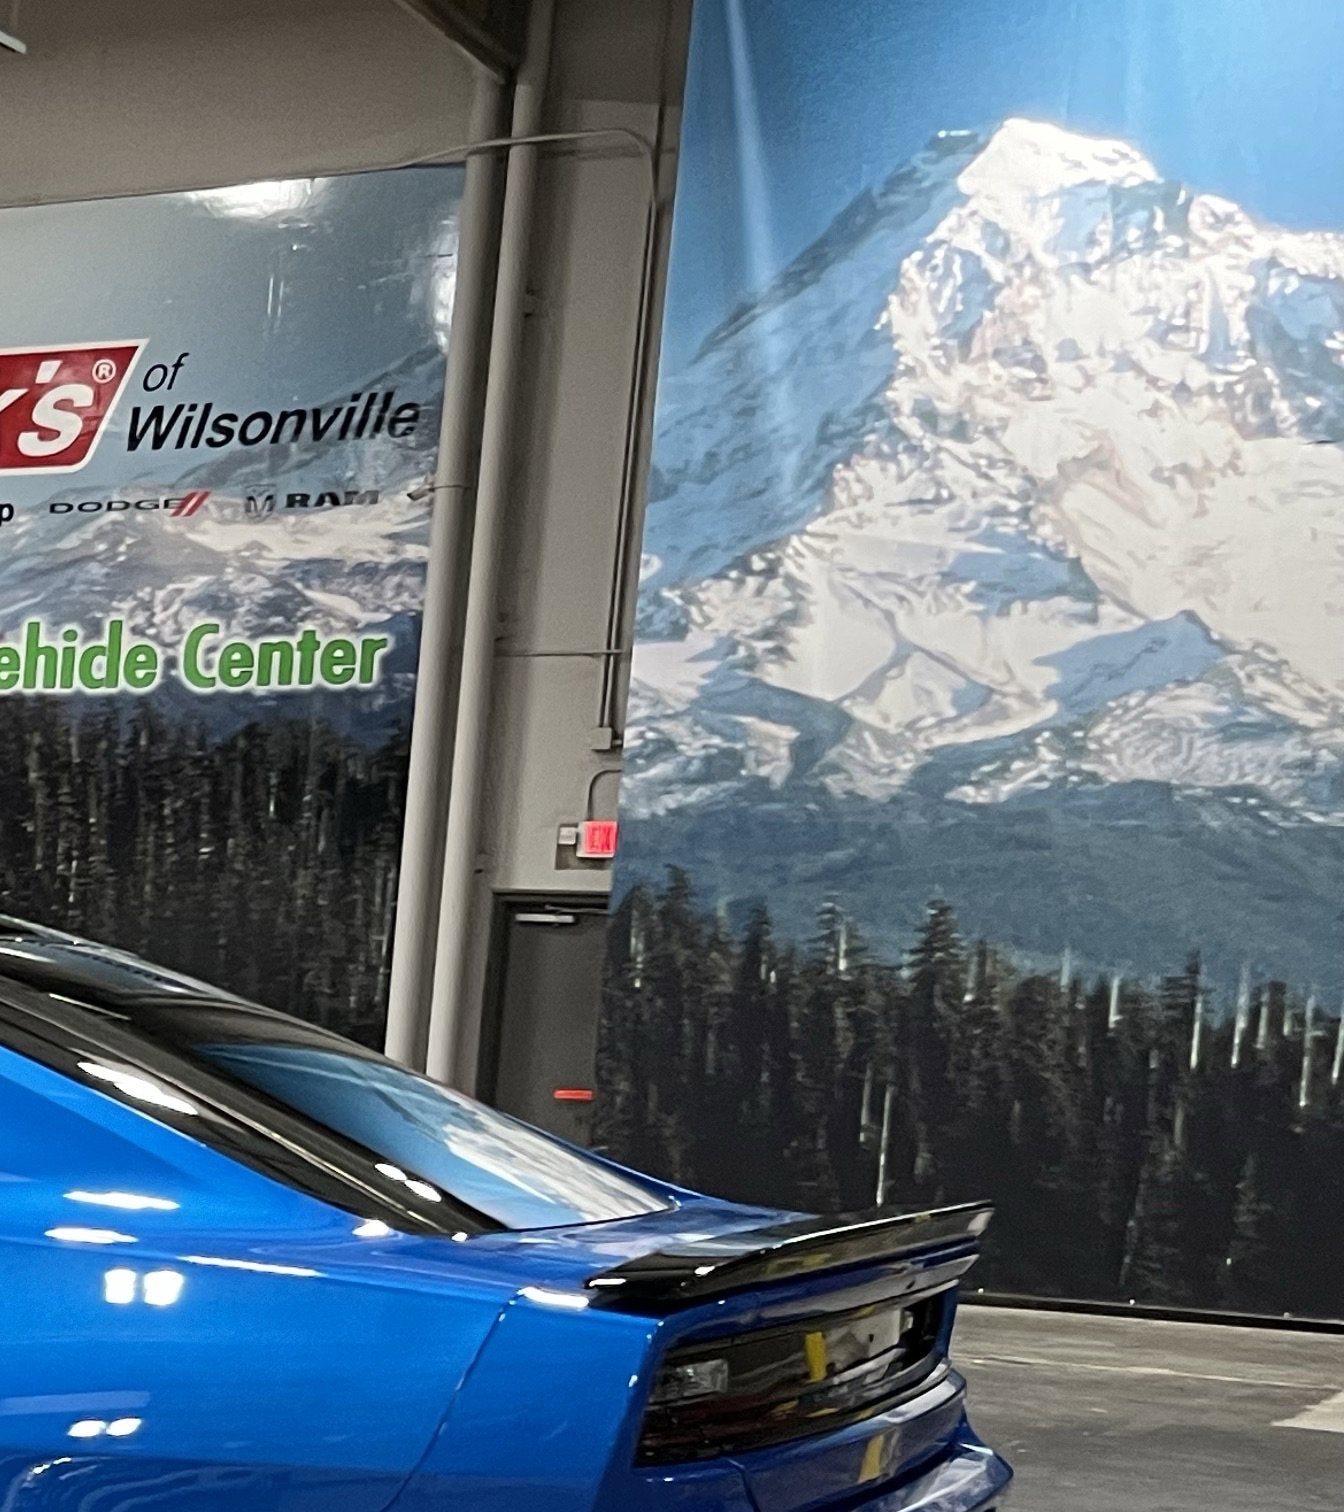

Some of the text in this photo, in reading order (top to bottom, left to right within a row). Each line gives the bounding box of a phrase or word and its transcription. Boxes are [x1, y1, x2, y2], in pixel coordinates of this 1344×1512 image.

[143, 352, 190, 392] of
[126, 388, 421, 452] Wilsonville
[48, 496, 185, 515] DODGE
[285, 490, 380, 509] RAM
[183, 622, 388, 689] Center
